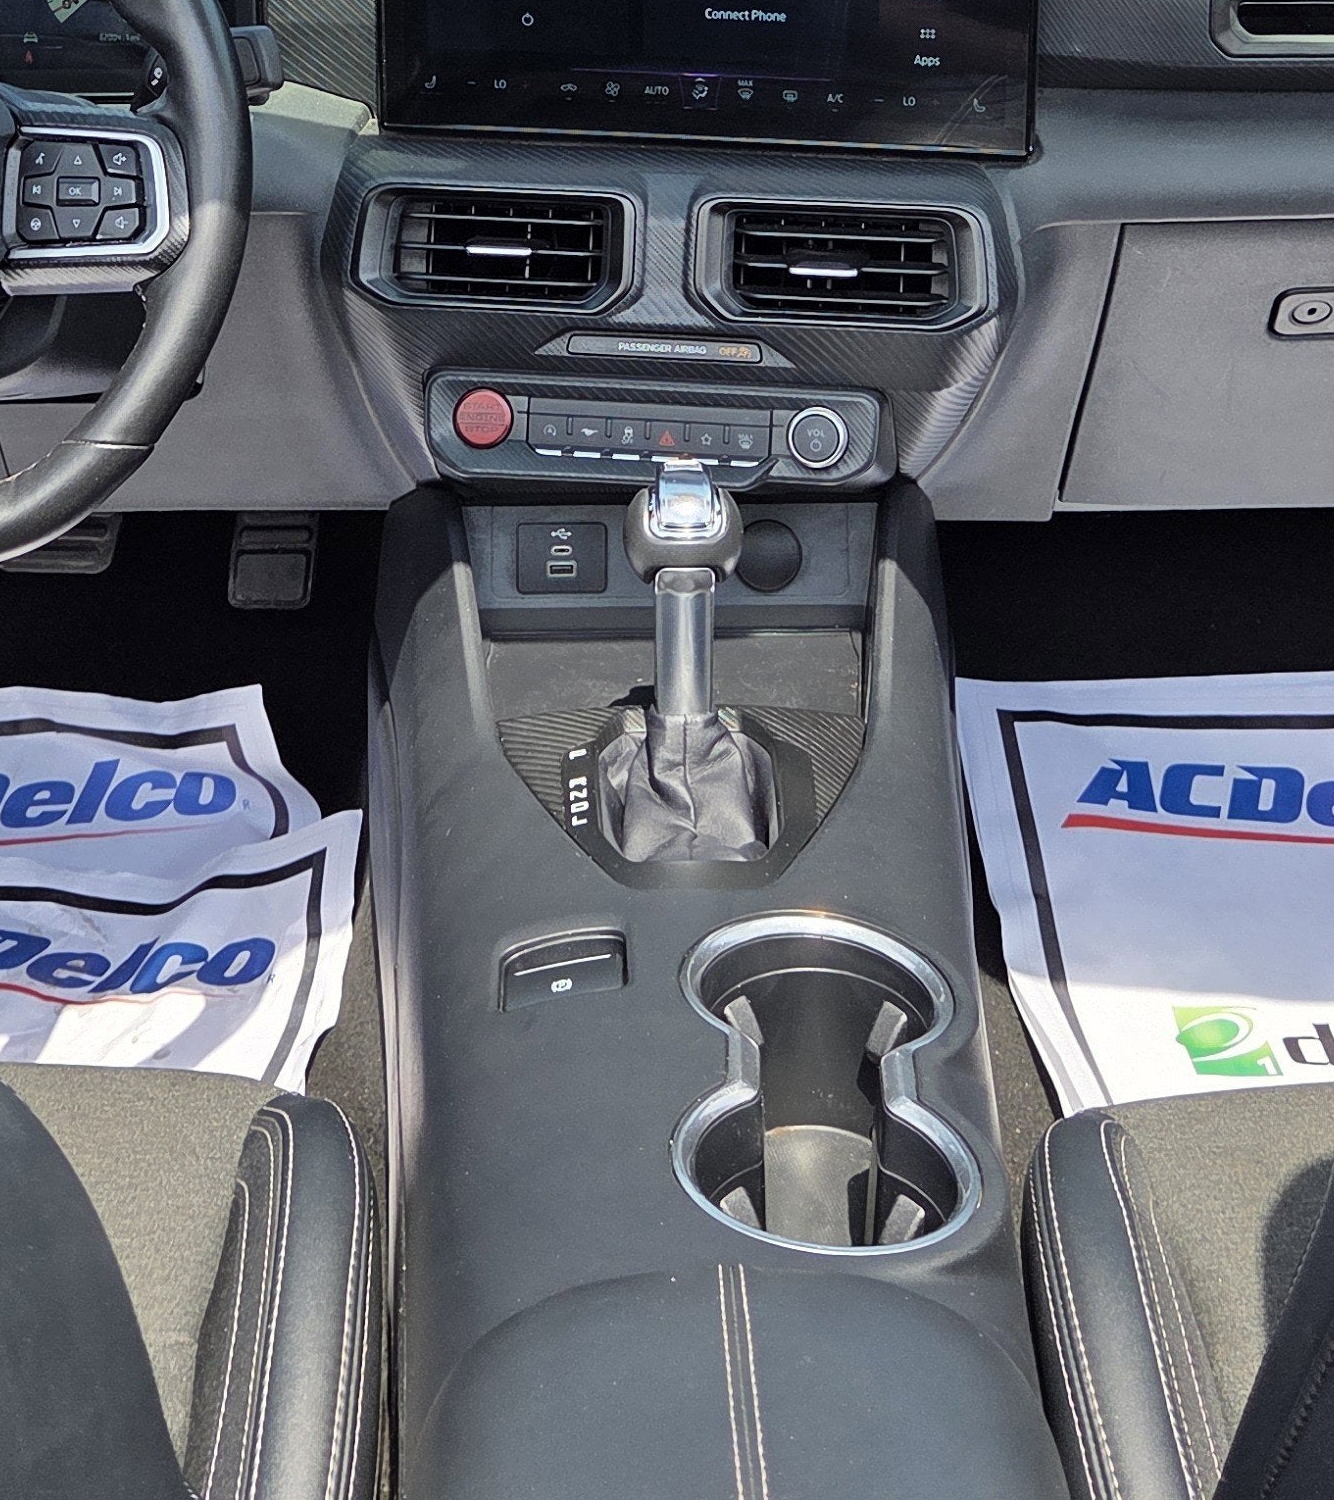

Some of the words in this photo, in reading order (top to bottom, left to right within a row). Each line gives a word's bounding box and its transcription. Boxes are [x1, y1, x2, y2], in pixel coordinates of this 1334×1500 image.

[704, 7, 750, 21] Connect
[752, 8, 787, 23] Phone
[913, 54, 941, 69] Apps
[493, 78, 507, 90] LO
[737, 78, 754, 87] MAX
[644, 84, 670, 96] AUTO
[825, 91, 844, 104] A/C
[902, 95, 917, 108] LO
[68, 187, 83, 197] OK
[618, 341, 672, 353] PASSENGER
[674, 344, 707, 355] AIRBAG
[807, 428, 825, 437] VOL
